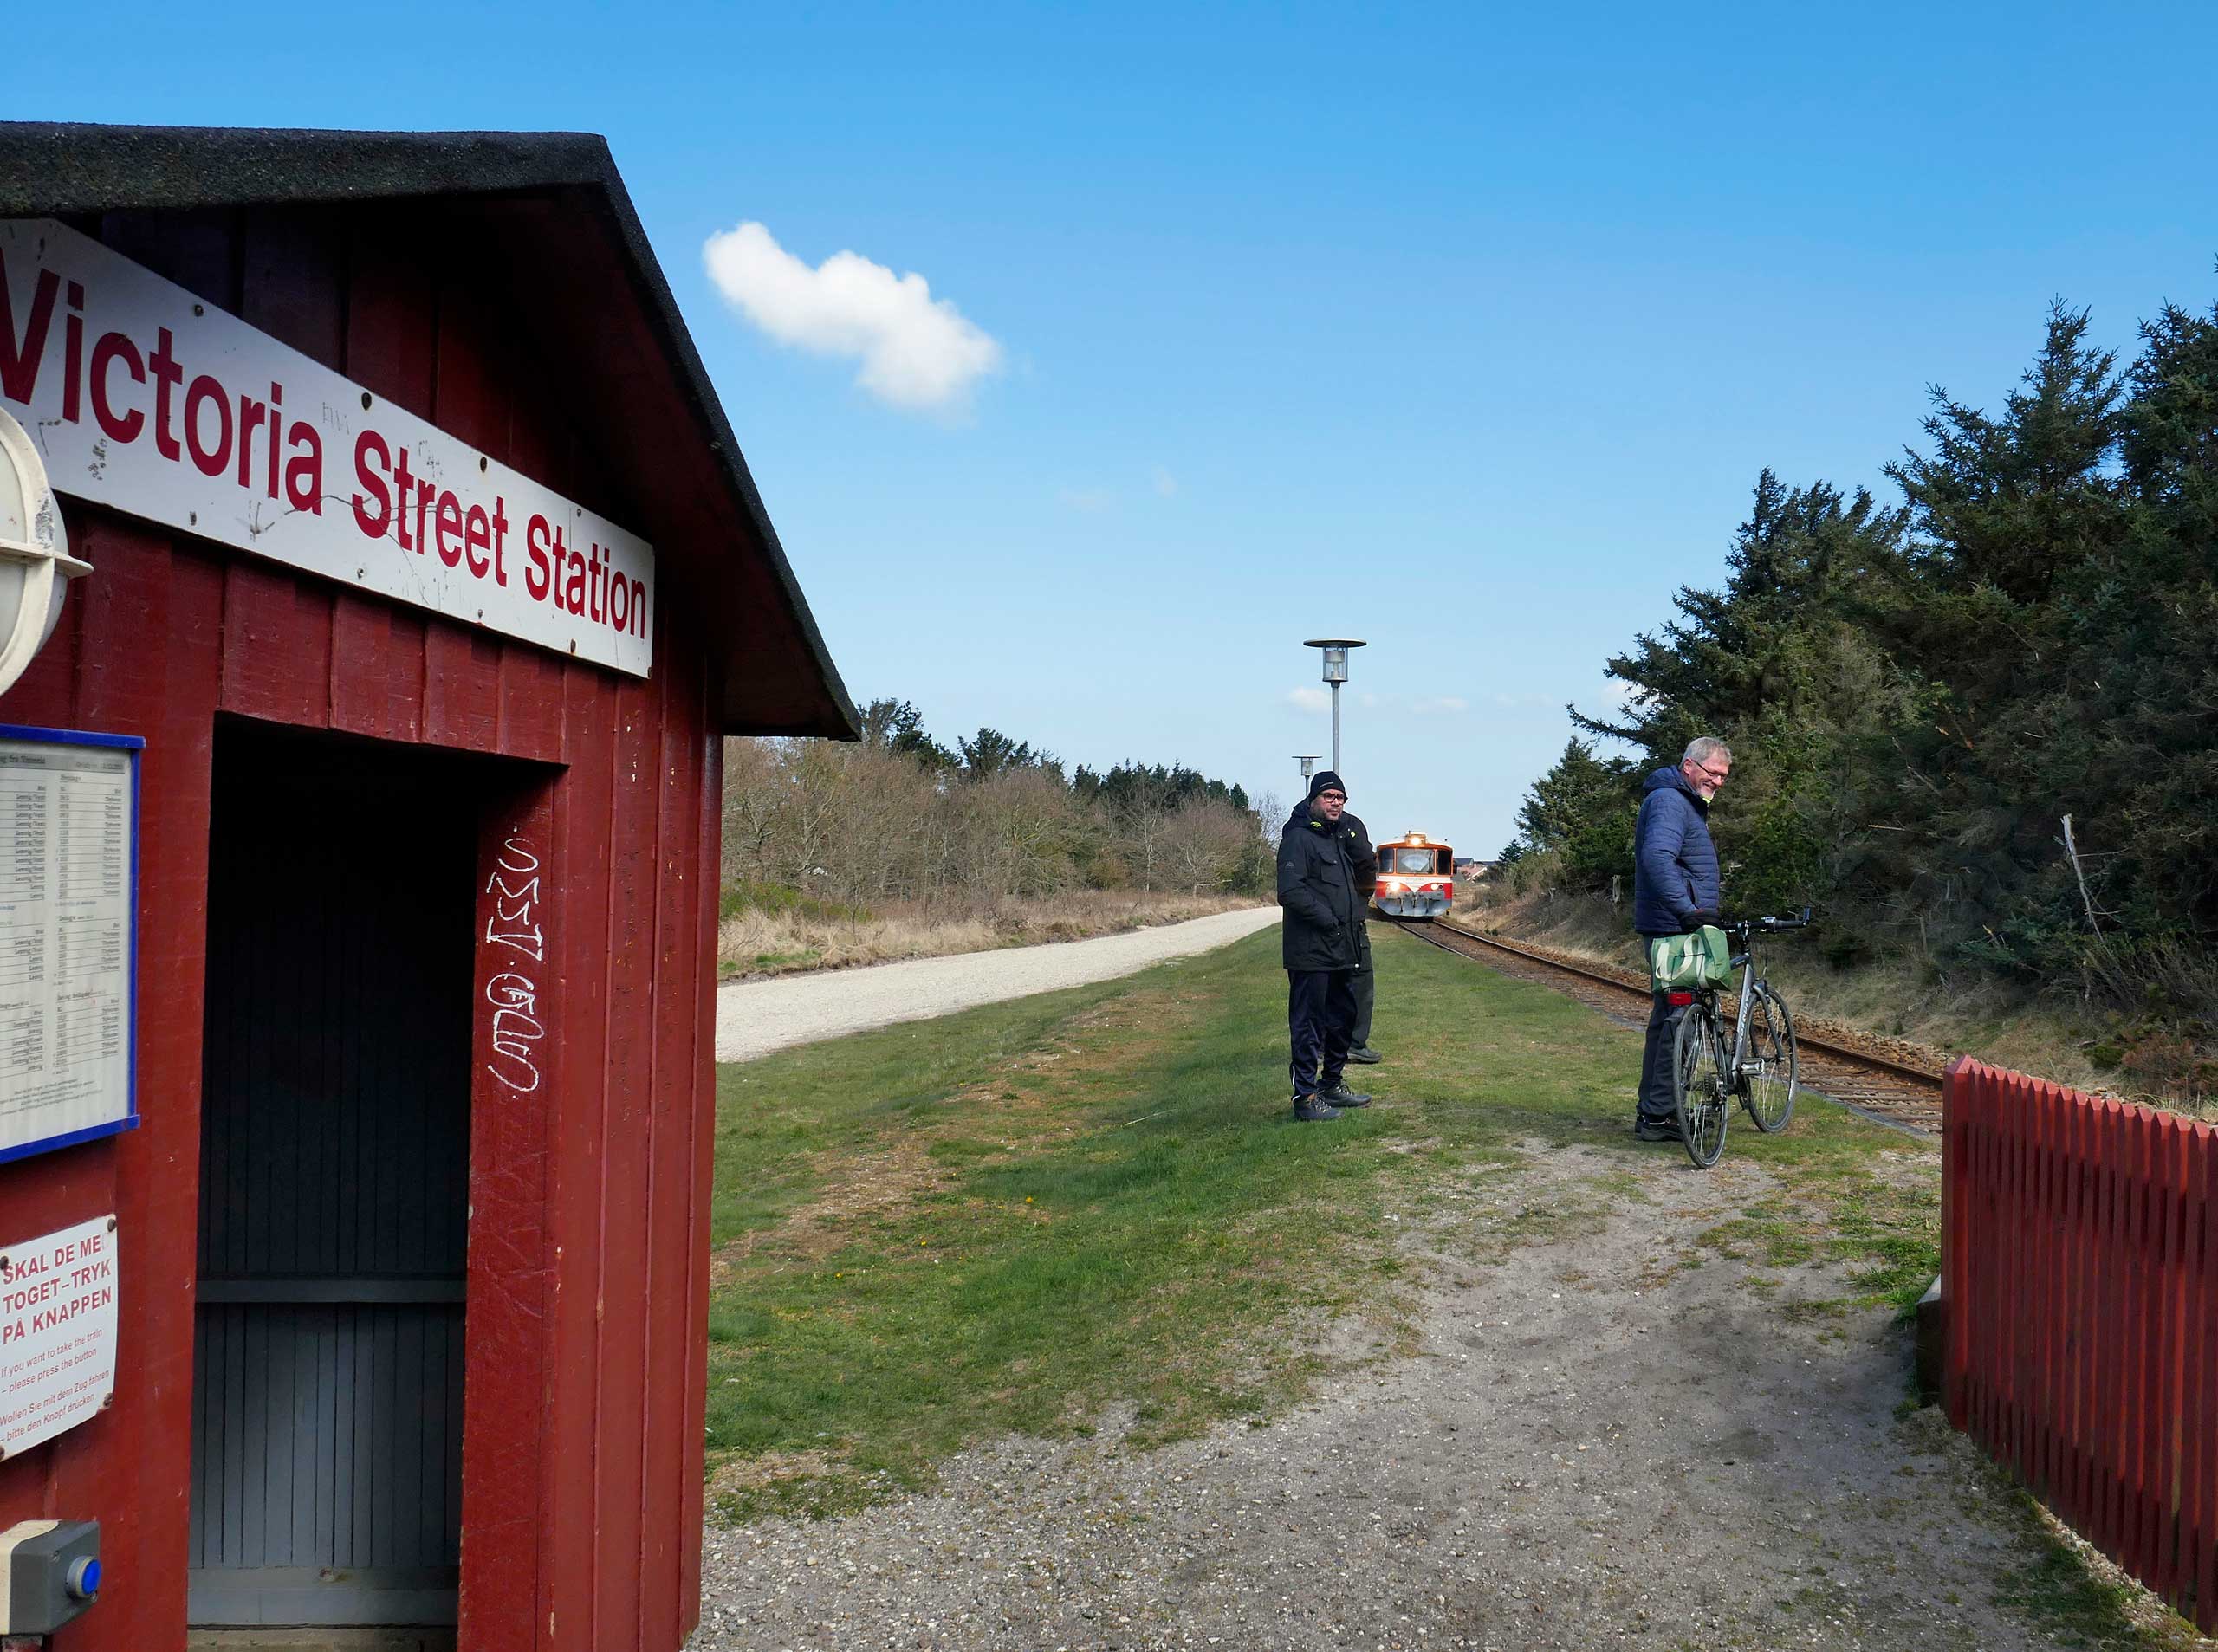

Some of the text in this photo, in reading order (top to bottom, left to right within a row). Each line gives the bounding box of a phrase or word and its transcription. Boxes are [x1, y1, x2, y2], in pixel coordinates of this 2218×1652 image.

[0, 248, 646, 639] Victoria Street Station
[3, 1254, 49, 1285] SKAL
[55, 1244, 75, 1267] DE
[3, 1286, 111, 1344] PÅ KNAPPEN
[9, 1363, 24, 1377] you
[27, 1352, 45, 1367] want
[48, 1350, 55, 1358] to
[56, 1342, 73, 1355] take
[75, 1337, 86, 1347] the
[87, 1329, 102, 1342] train
[9, 1377, 36, 1395] please
[37, 1365, 59, 1382] press
[61, 1359, 73, 1370] the
[75, 1348, 97, 1364] button
[43, 1395, 55, 1407] mit
[57, 1387, 73, 1401] dem
[7, 1426, 25, 1441] bitte
[27, 1420, 42, 1432] den
[43, 1406, 66, 1424] Knopf
